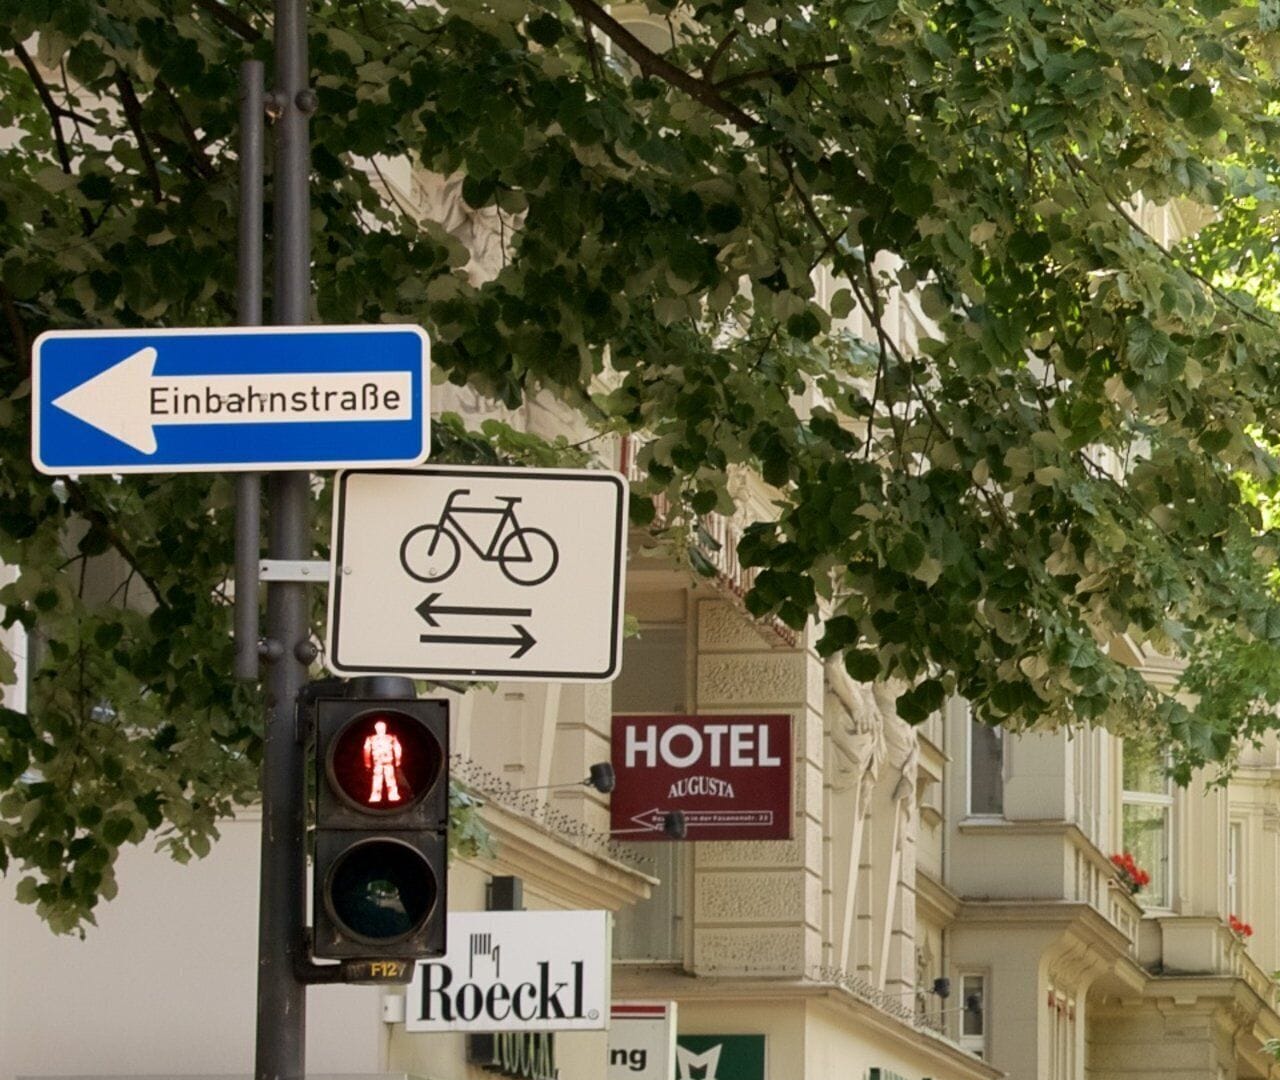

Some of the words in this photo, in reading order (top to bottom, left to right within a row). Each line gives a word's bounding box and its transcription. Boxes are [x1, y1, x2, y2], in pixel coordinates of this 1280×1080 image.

[149, 381, 402, 415] Einbahnstraße
[625, 724, 781, 768] HOTEL
[668, 775, 734, 798] AUGUSTA
[417, 961, 585, 1021] Roeckl
